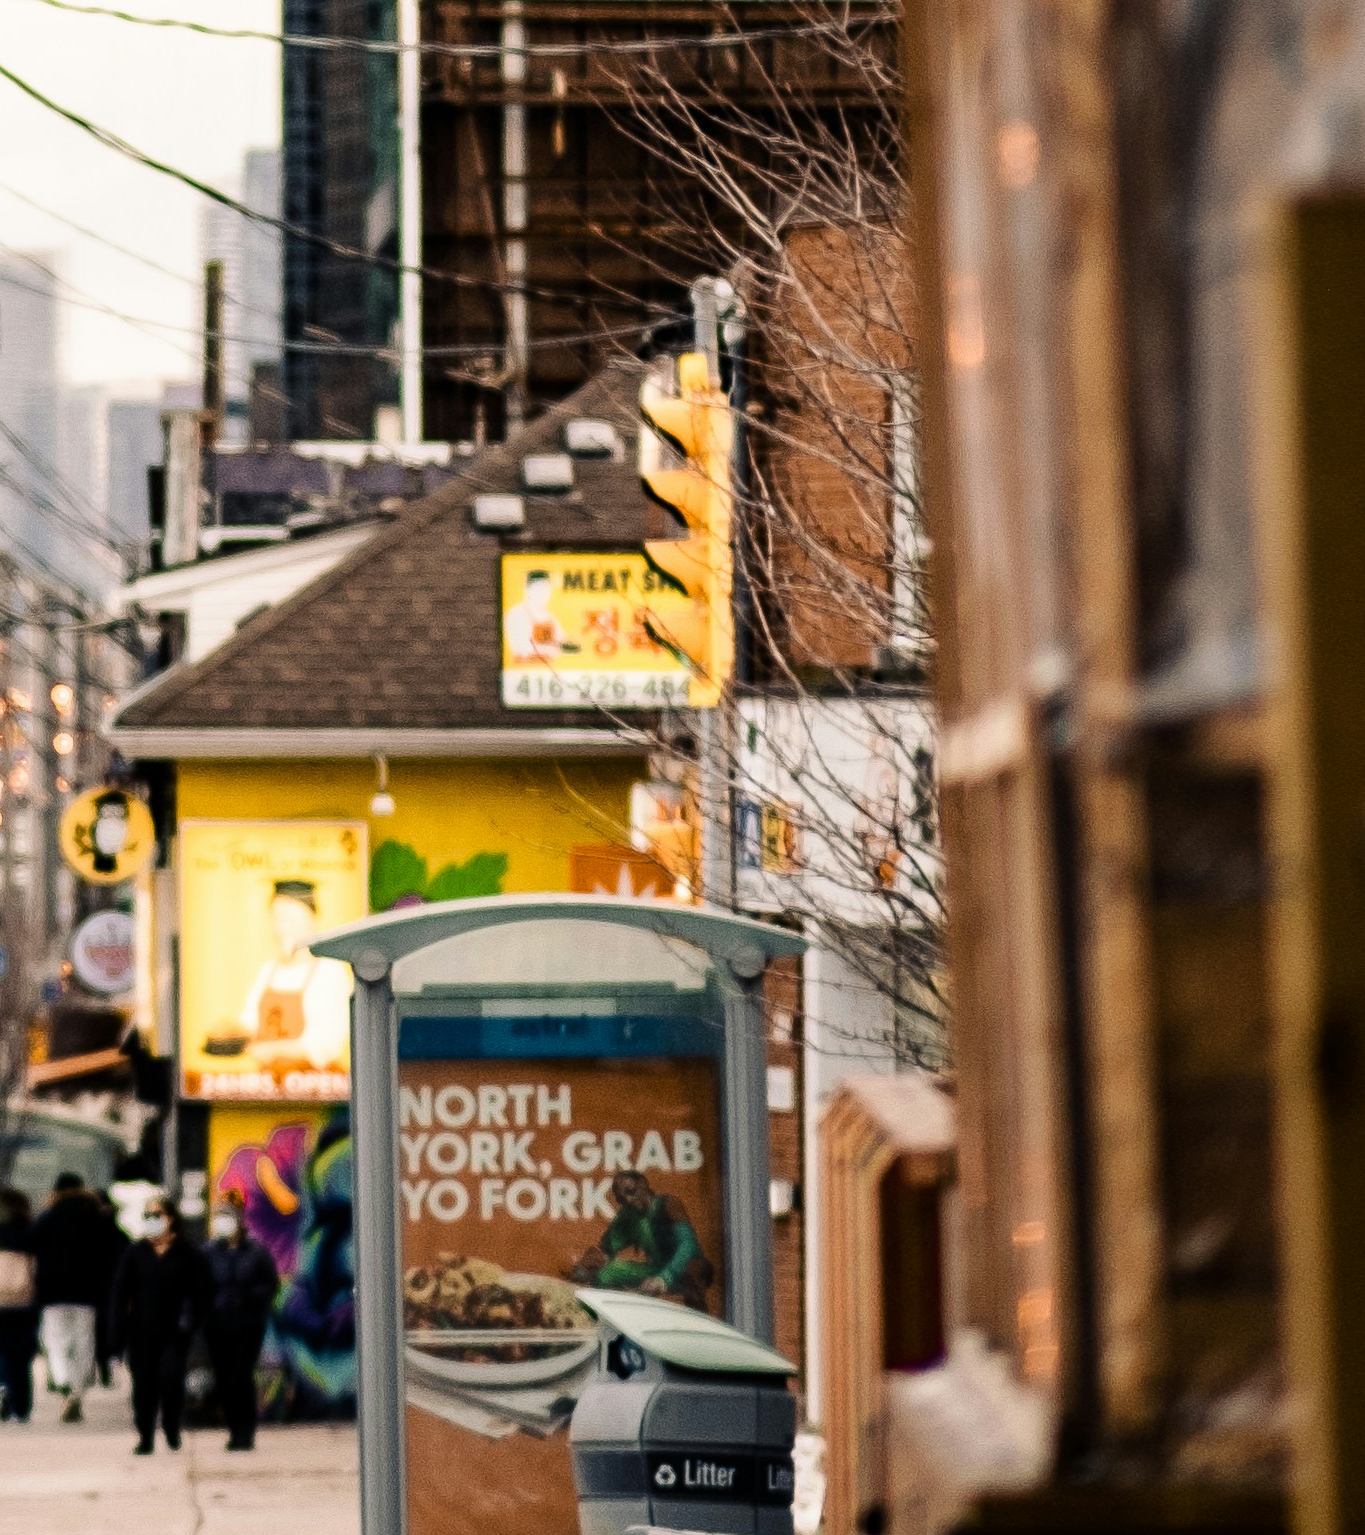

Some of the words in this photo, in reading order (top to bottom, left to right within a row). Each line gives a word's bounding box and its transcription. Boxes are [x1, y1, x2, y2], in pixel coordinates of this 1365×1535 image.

[563, 569, 631, 591] MEAT
[399, 1084, 571, 1126] NORTH
[400, 1132, 553, 1178] YORK,
[561, 1129, 704, 1173] GRAB
[400, 1179, 470, 1222] YO
[480, 1178, 618, 1222] FORK
[684, 1459, 736, 1488] Litter
